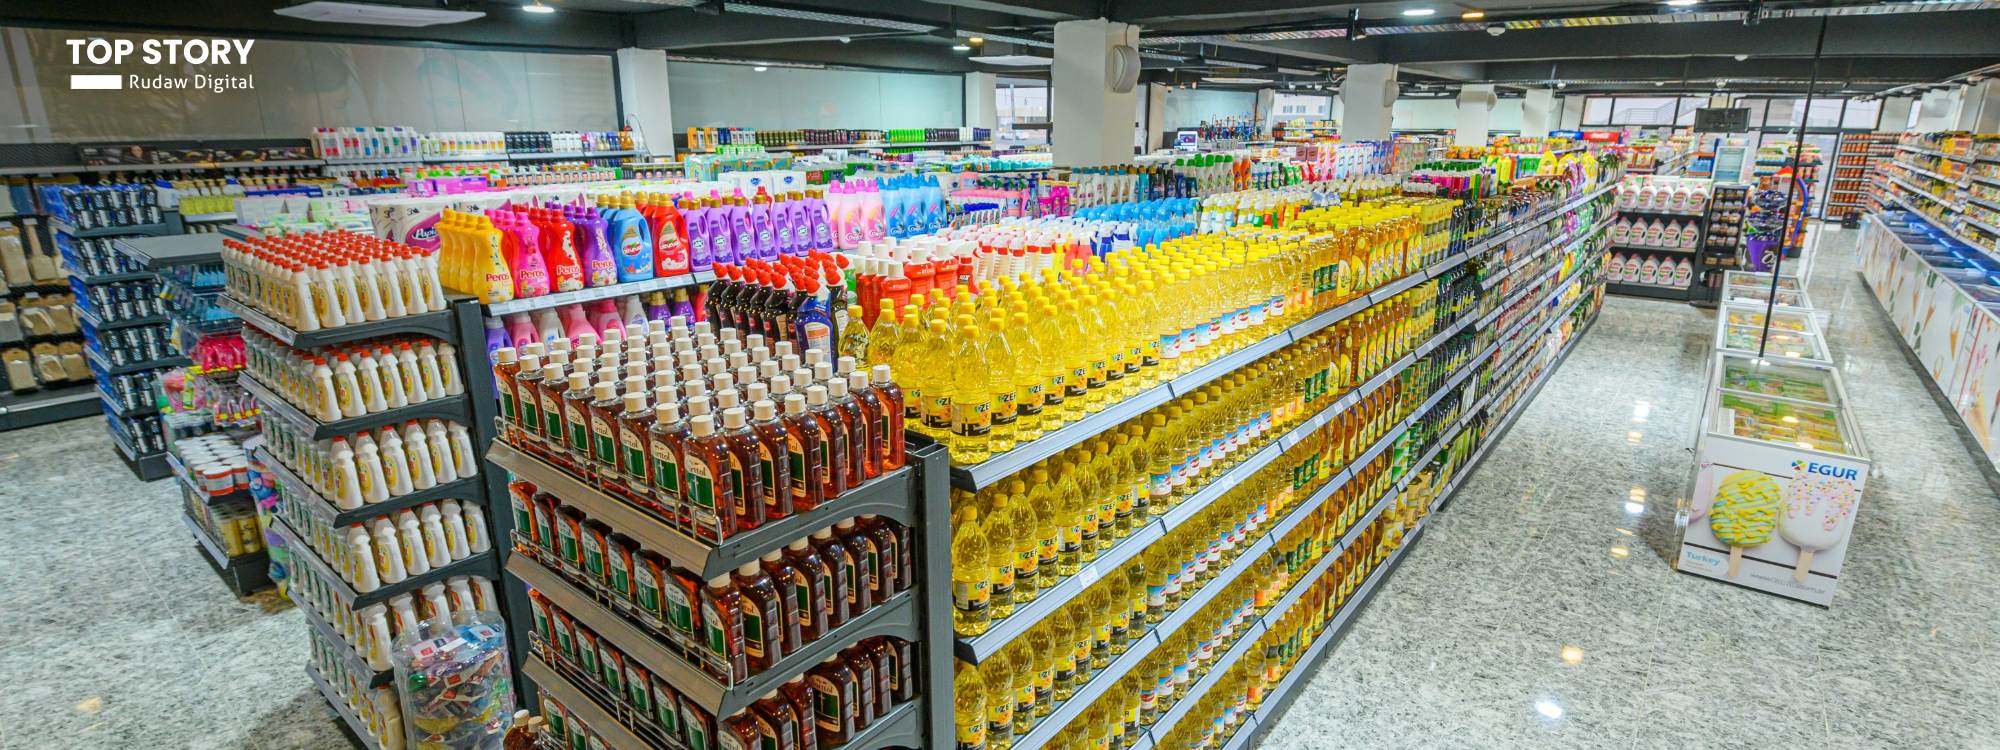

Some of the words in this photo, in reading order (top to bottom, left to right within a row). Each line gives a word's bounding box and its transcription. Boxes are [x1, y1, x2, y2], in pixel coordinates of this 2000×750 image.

[485, 272, 510, 282] Peros
[520, 269, 545, 280] Peros
[1808, 462, 1858, 480] EGUR
[1685, 551, 1720, 567] Turkey
